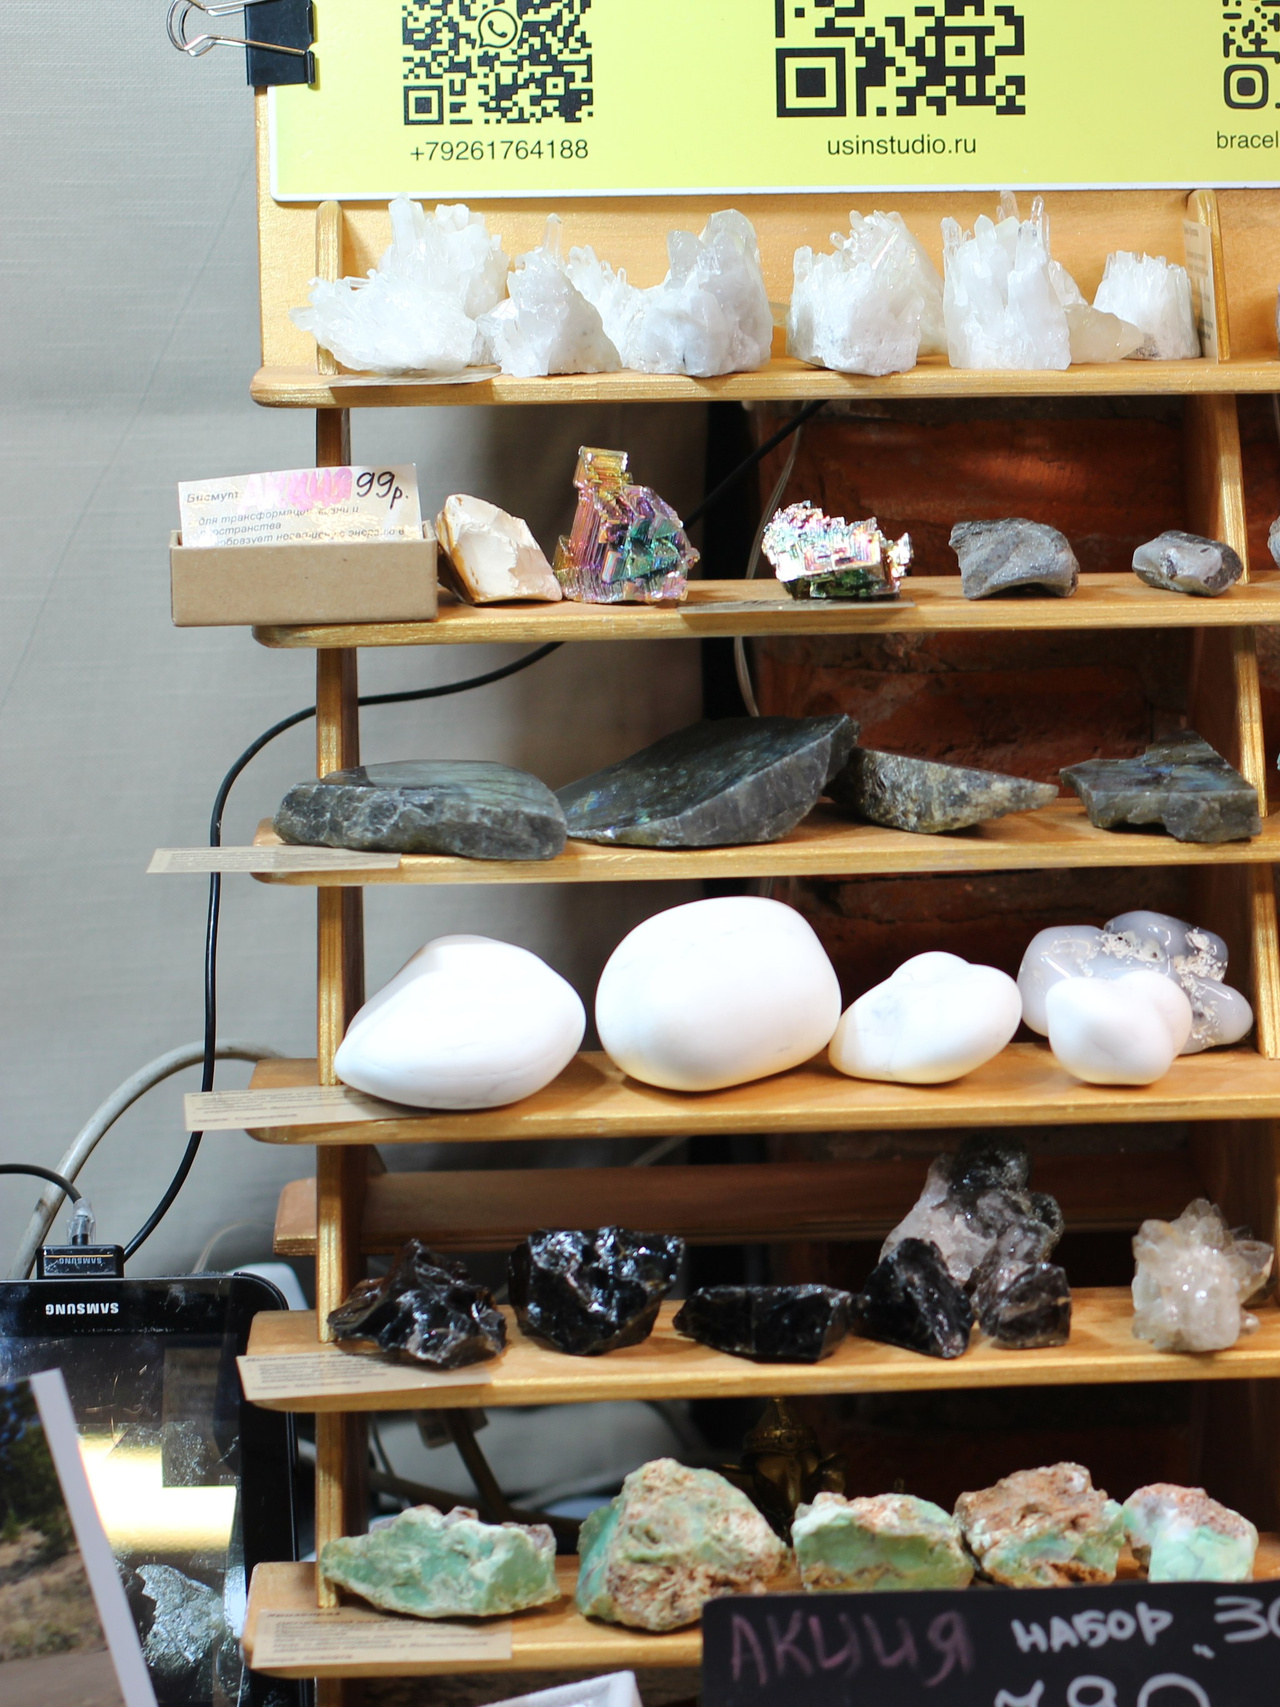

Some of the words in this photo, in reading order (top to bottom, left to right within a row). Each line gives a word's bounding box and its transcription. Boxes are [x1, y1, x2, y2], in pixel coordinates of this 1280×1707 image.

[410, 139, 589, 163] +79261764188
[827, 135, 977, 158] usinstudio.ru
[59, 1257, 102, 1265] SAMSUNG
[45, 1302, 120, 1315] SAMSUNG
[1011, 1602, 1174, 1652] НАБОР
